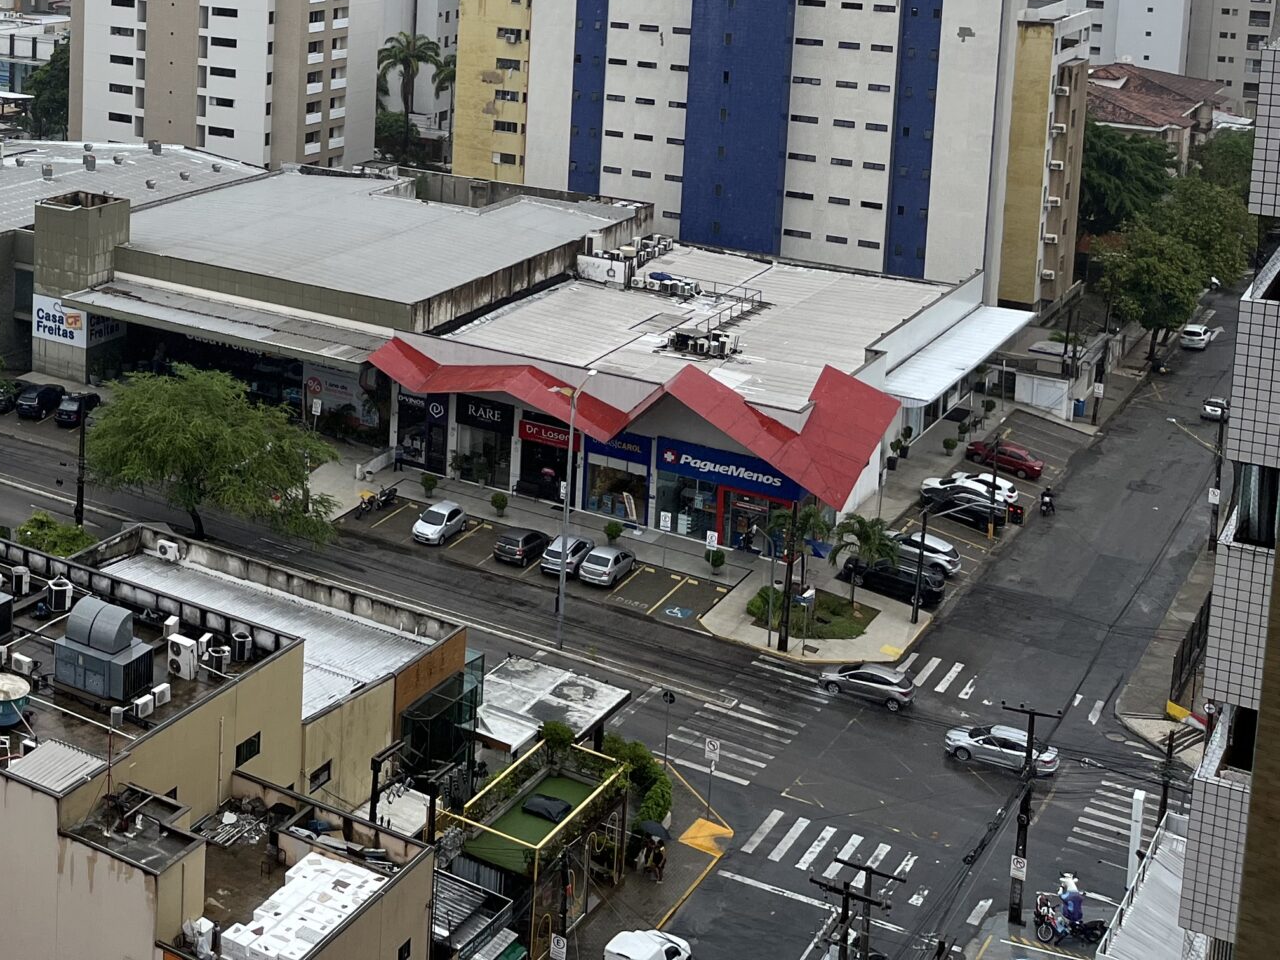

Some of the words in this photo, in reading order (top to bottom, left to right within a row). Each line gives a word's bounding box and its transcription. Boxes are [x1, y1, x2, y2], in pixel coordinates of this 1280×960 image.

[36, 308, 64, 325] Casa
[66, 315, 80, 327] CF
[36, 320, 75, 340] Freitas
[90, 323, 120, 341] Freitas
[468, 404, 501, 422] RARE
[526, 424, 539, 434] Dr
[541, 429, 570, 440] Laser
[617, 441, 642, 453] CAROL
[679, 454, 783, 487] PagueMenos
[556, 939, 561, 947] E
